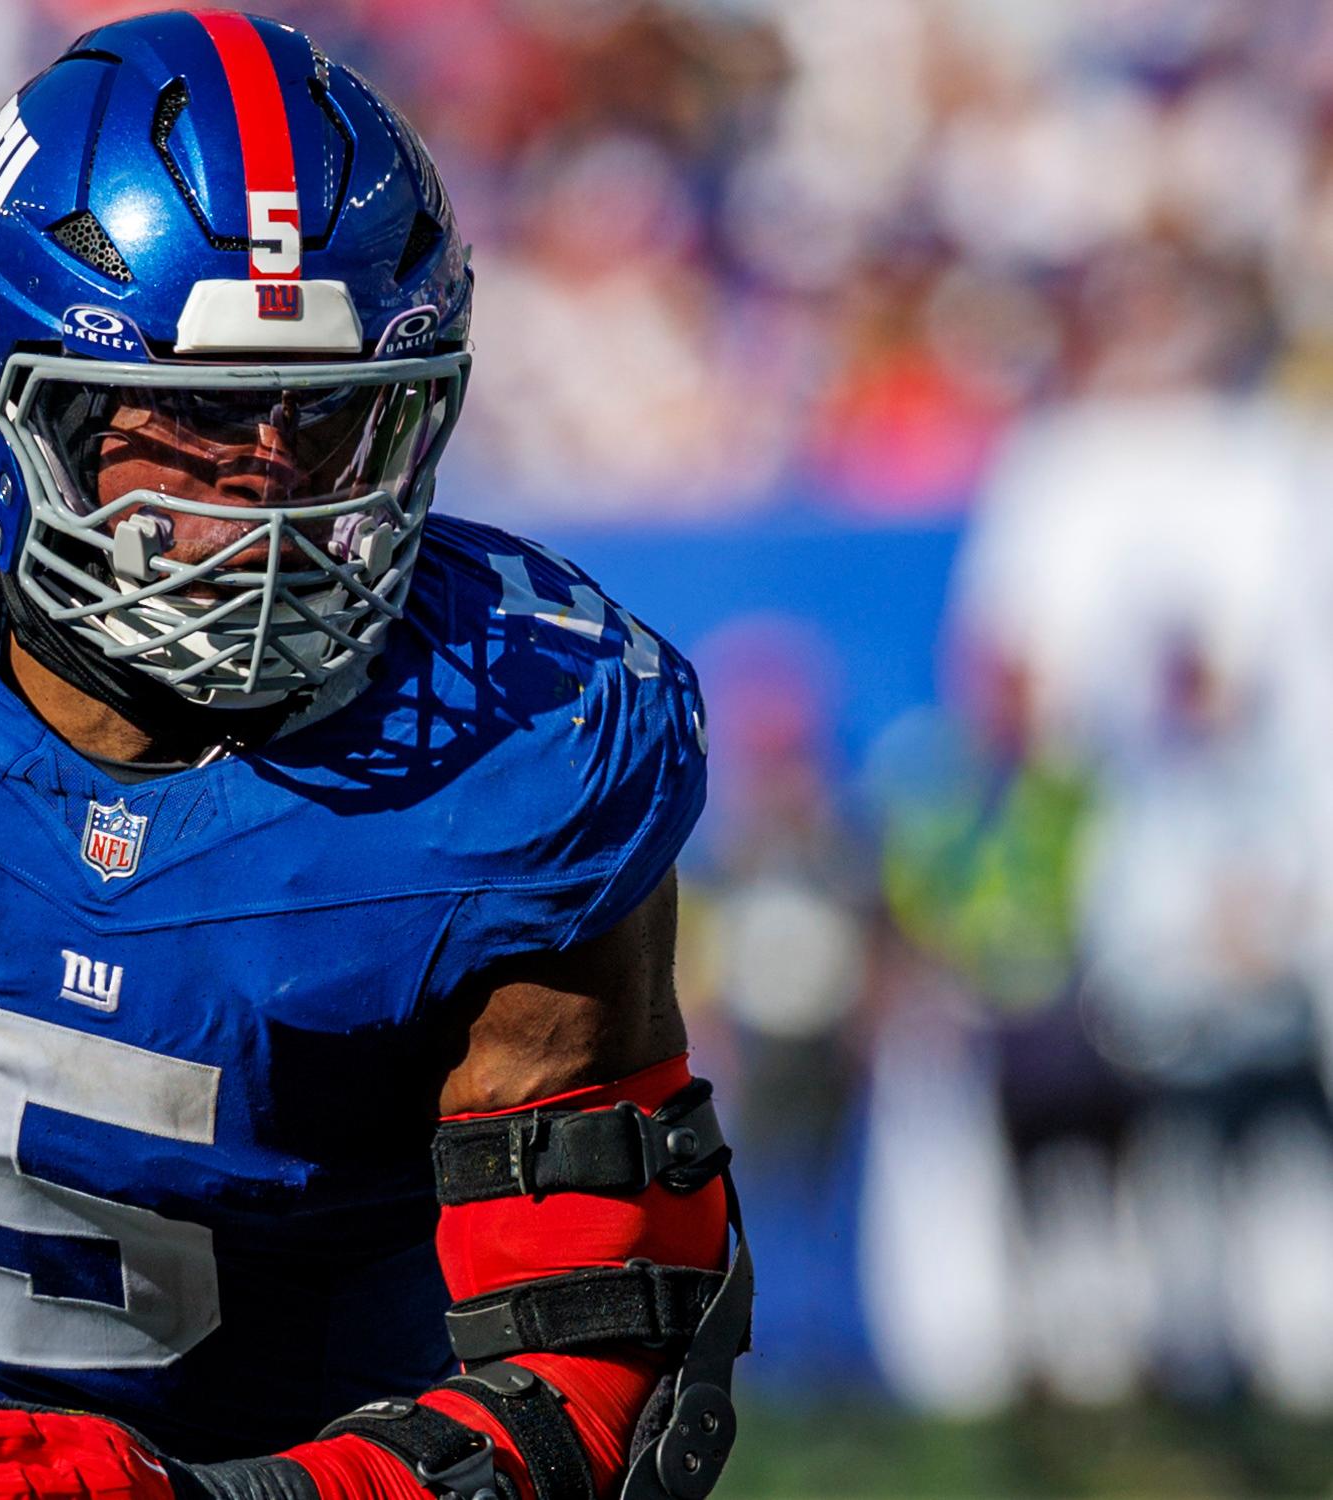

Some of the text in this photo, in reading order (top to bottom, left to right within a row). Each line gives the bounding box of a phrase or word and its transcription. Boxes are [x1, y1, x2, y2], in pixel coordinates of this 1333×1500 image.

[249, 191, 298, 274] 5
[64, 324, 135, 351] OAKLEY
[386, 332, 435, 353] OAKLEY
[90, 833, 129, 867] NFL
